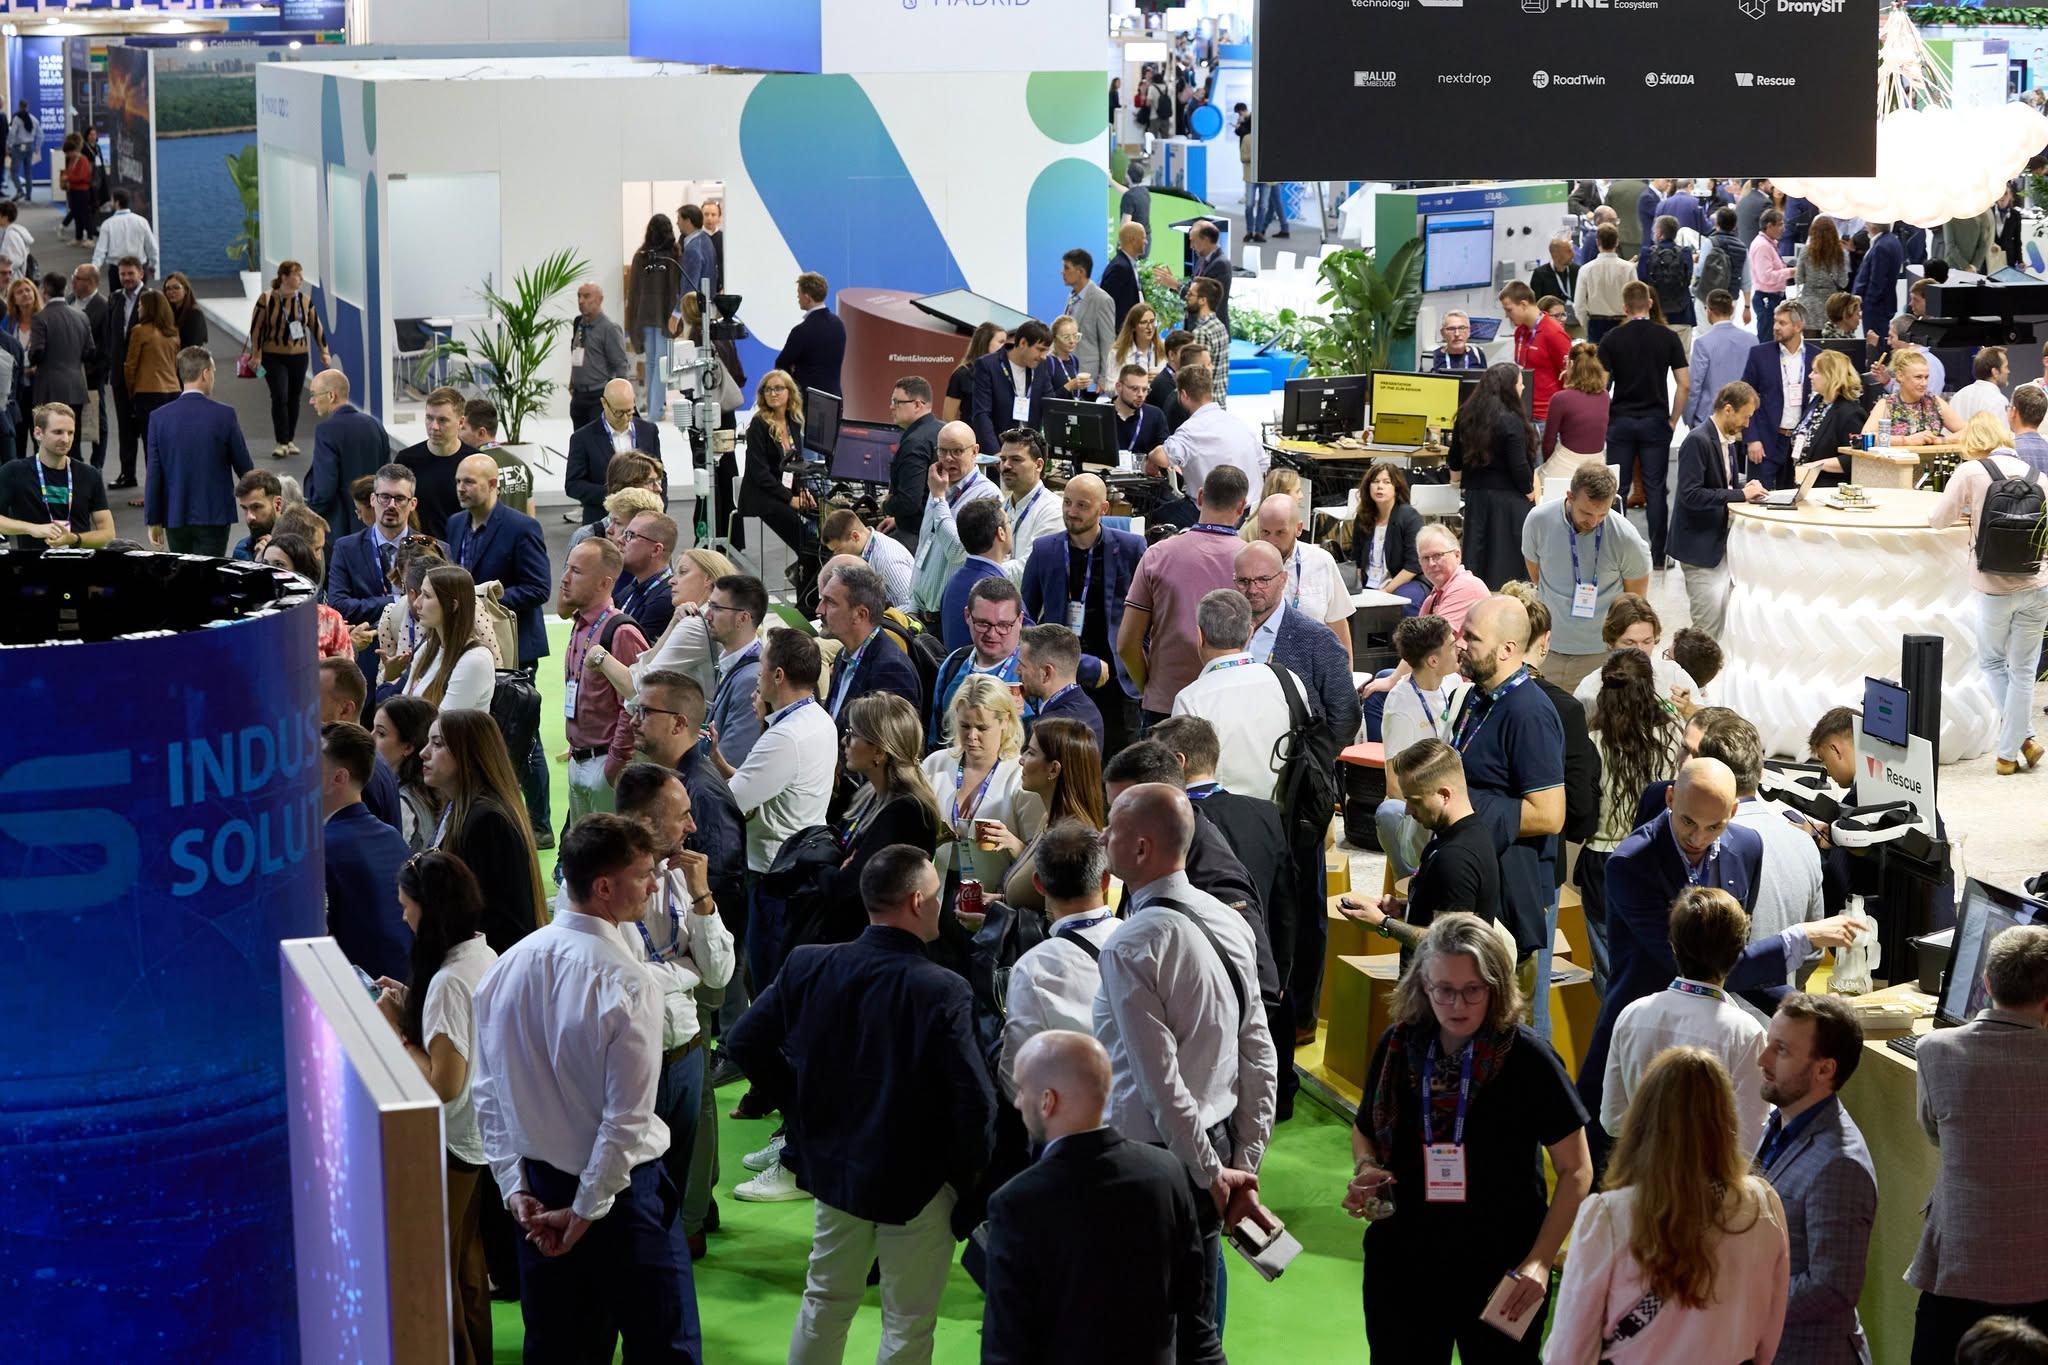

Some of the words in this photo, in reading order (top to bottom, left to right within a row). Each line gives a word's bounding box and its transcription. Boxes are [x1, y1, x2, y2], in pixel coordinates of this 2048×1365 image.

[1614, 0, 1658, 10] Ecosystem
[1777, 0, 1845, 16] DronySIT
[1438, 73, 1491, 88] nextdrop
[1553, 74, 1606, 86] RoadTwin
[1659, 73, 1695, 85] ŠKODA
[1757, 75, 1796, 86] Rescue
[888, 353, 954, 363] #Talent&Innovation
[1886, 767, 1922, 794] Rescue
